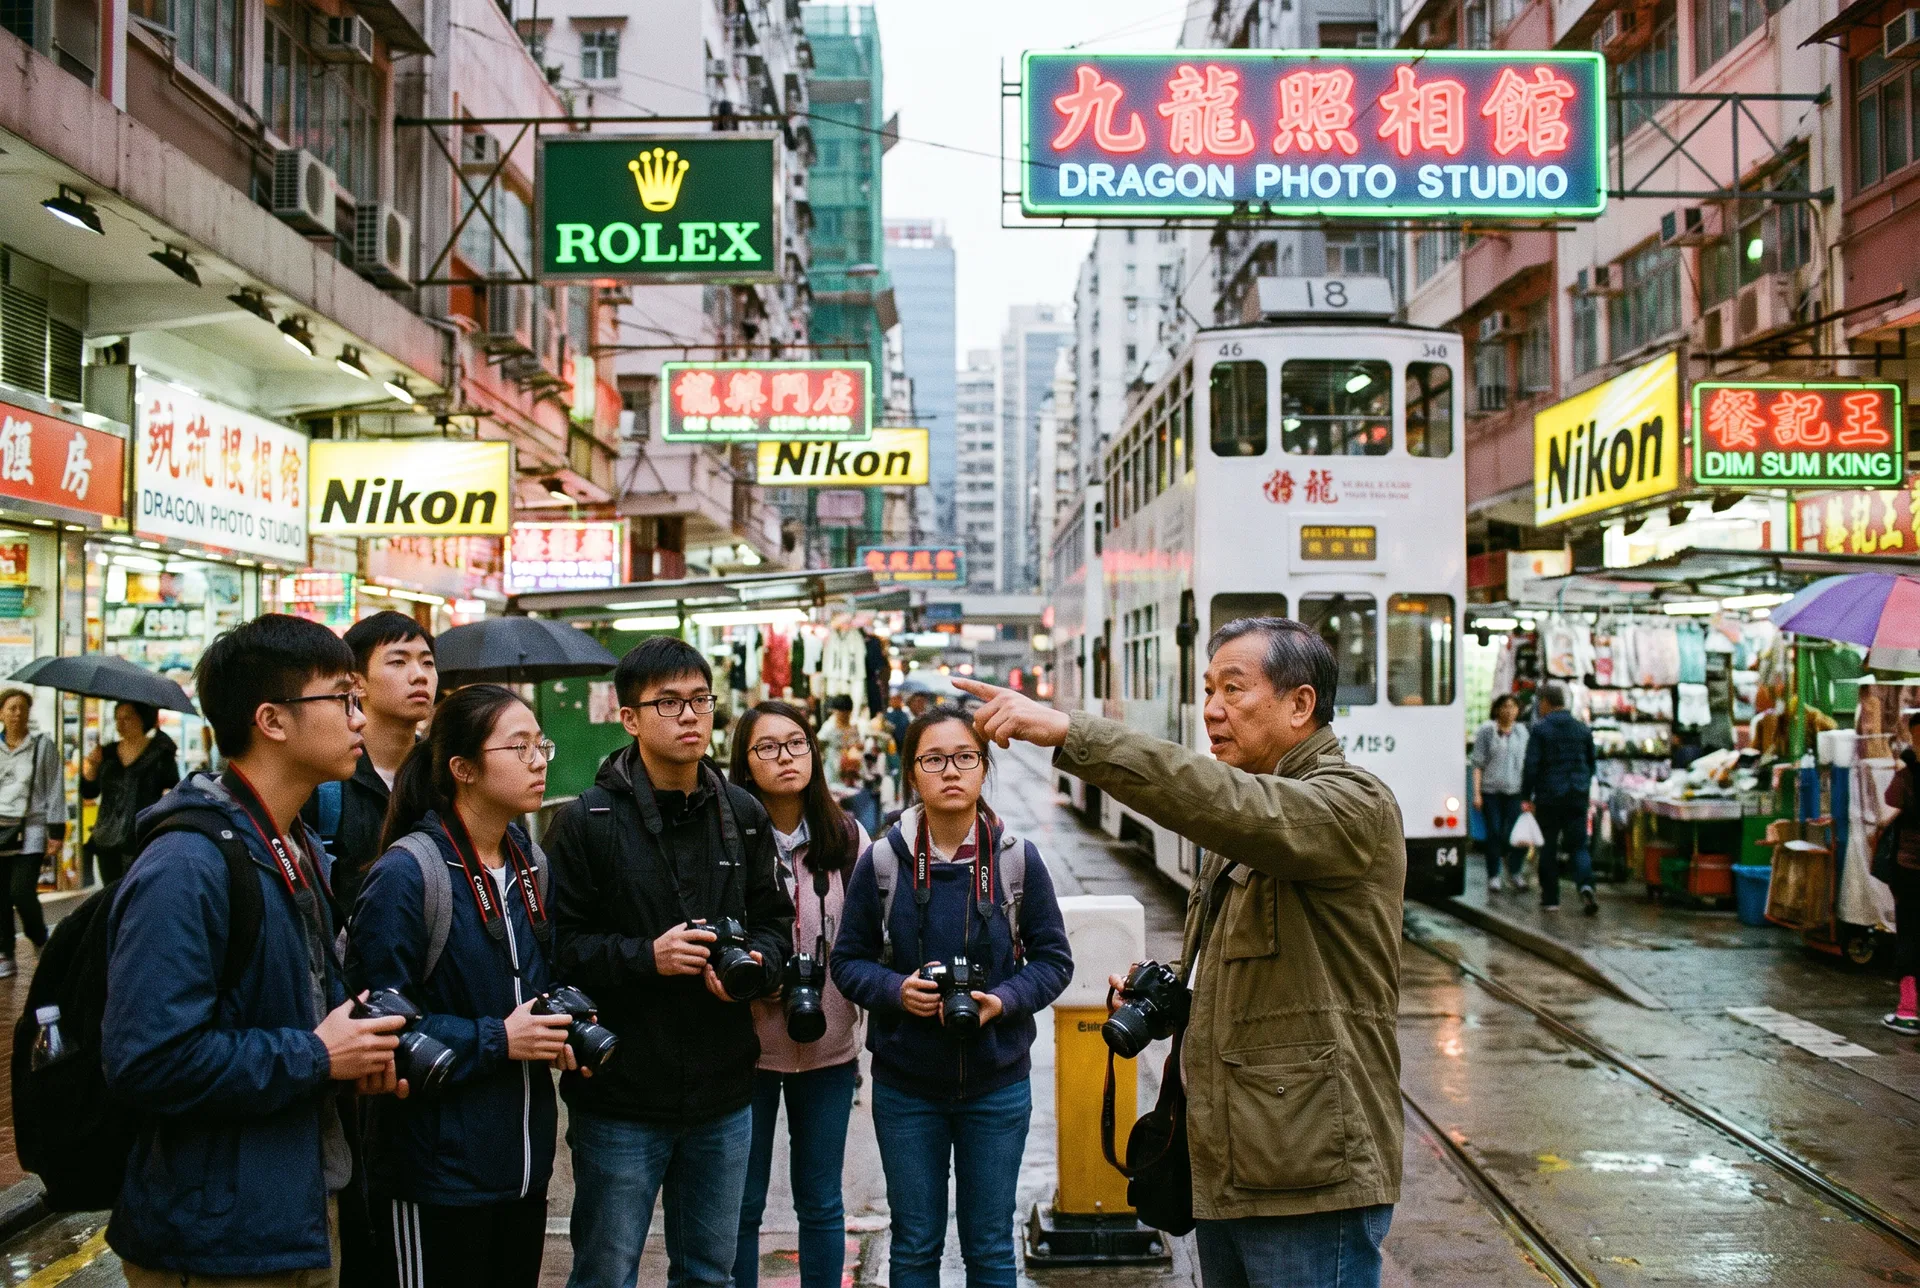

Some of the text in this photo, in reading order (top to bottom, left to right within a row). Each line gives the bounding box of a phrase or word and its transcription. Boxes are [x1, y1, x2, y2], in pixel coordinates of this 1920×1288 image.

[1052, 64, 1575, 157] 九龍照相館
[1059, 163, 1569, 199] DRAGON PHOTO STUDIO
[556, 222, 762, 264] ROLEX
[1306, 280, 1348, 308] 18
[1219, 343, 1243, 357] 46
[773, 441, 911, 476] Nikon
[1547, 415, 1663, 509] Nikon
[1705, 451, 1892, 477] DIM SUM KING
[143, 489, 301, 547] DRAGON PHOTO STUDIO
[320, 478, 497, 525] Nikon
